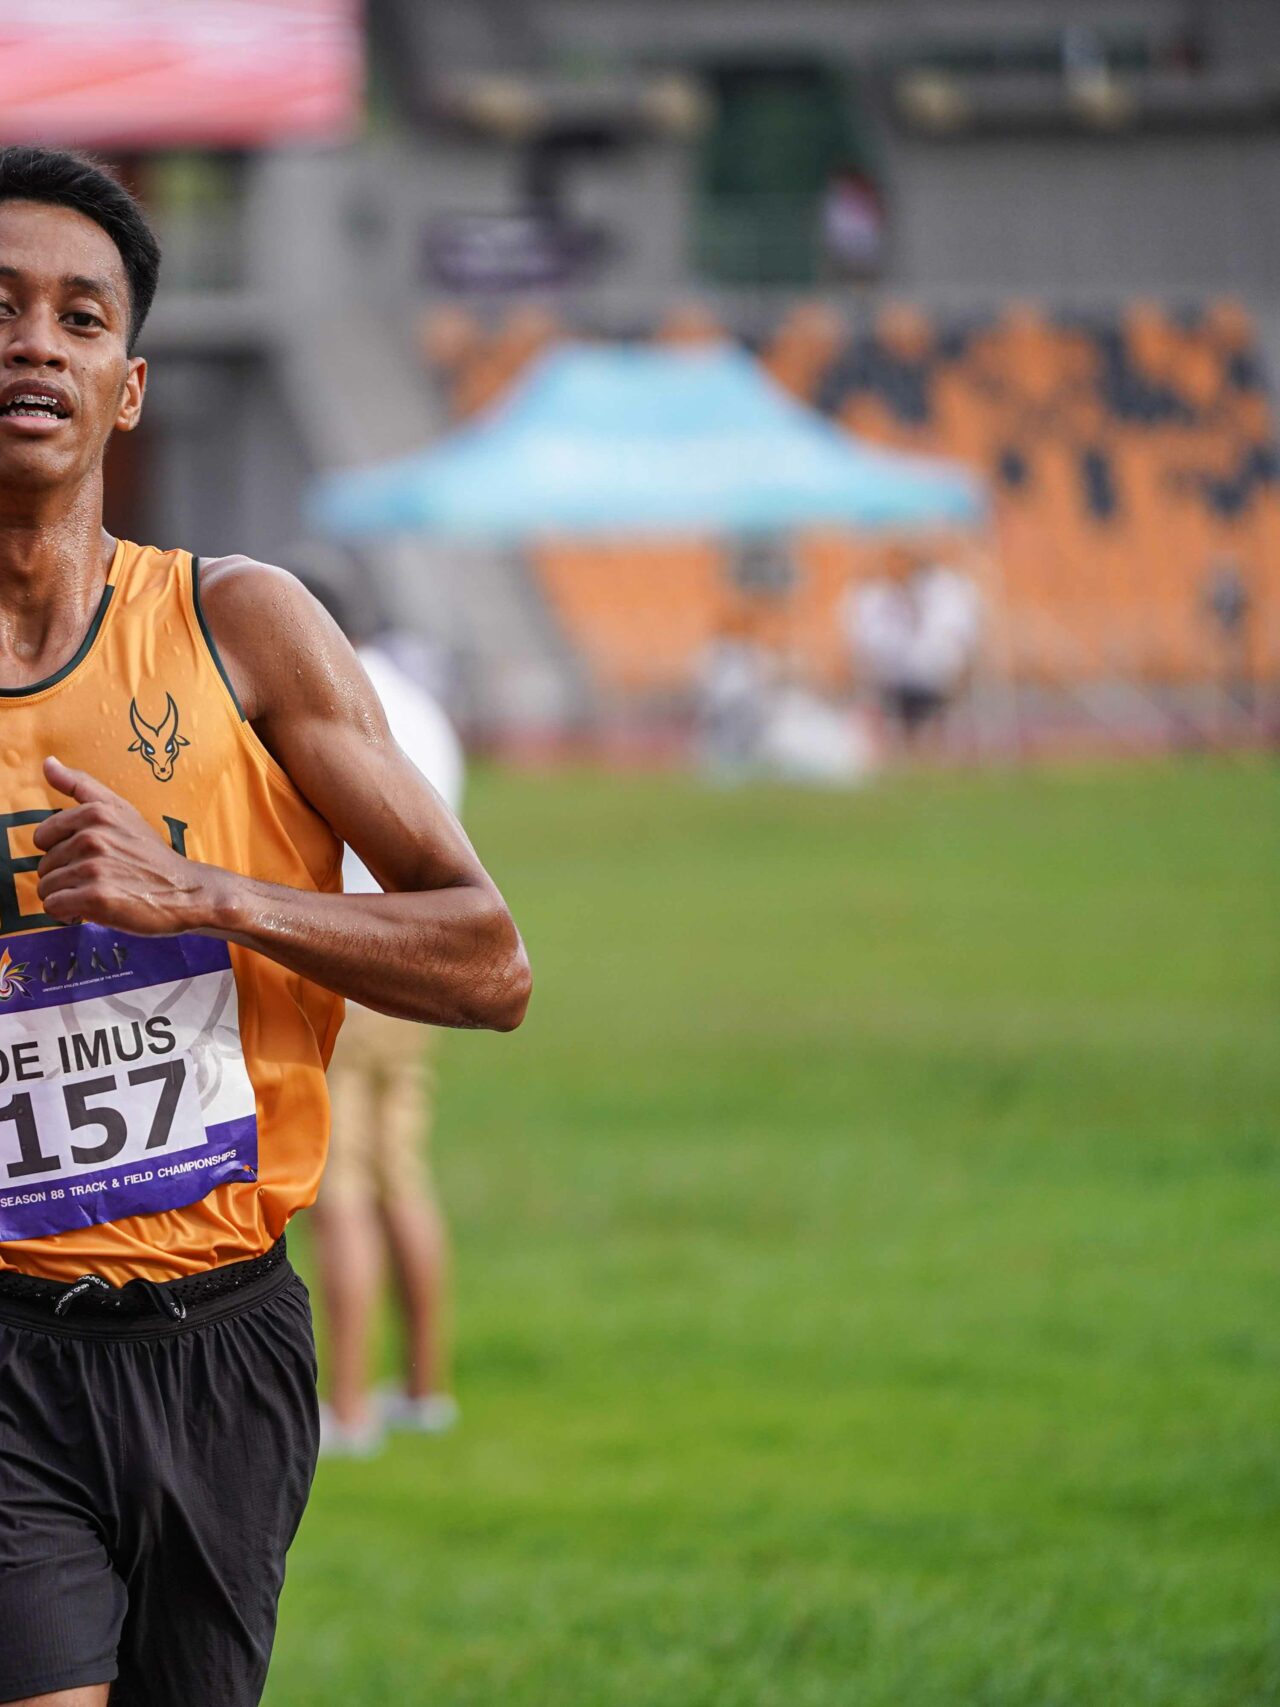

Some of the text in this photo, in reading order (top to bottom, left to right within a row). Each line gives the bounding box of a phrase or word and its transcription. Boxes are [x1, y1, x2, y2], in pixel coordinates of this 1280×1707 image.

[56, 1015, 177, 1074] IMUS
[0, 1149, 237, 1208] SEASON 88 TRACK & FIELD CHAMPIONSHIPS
